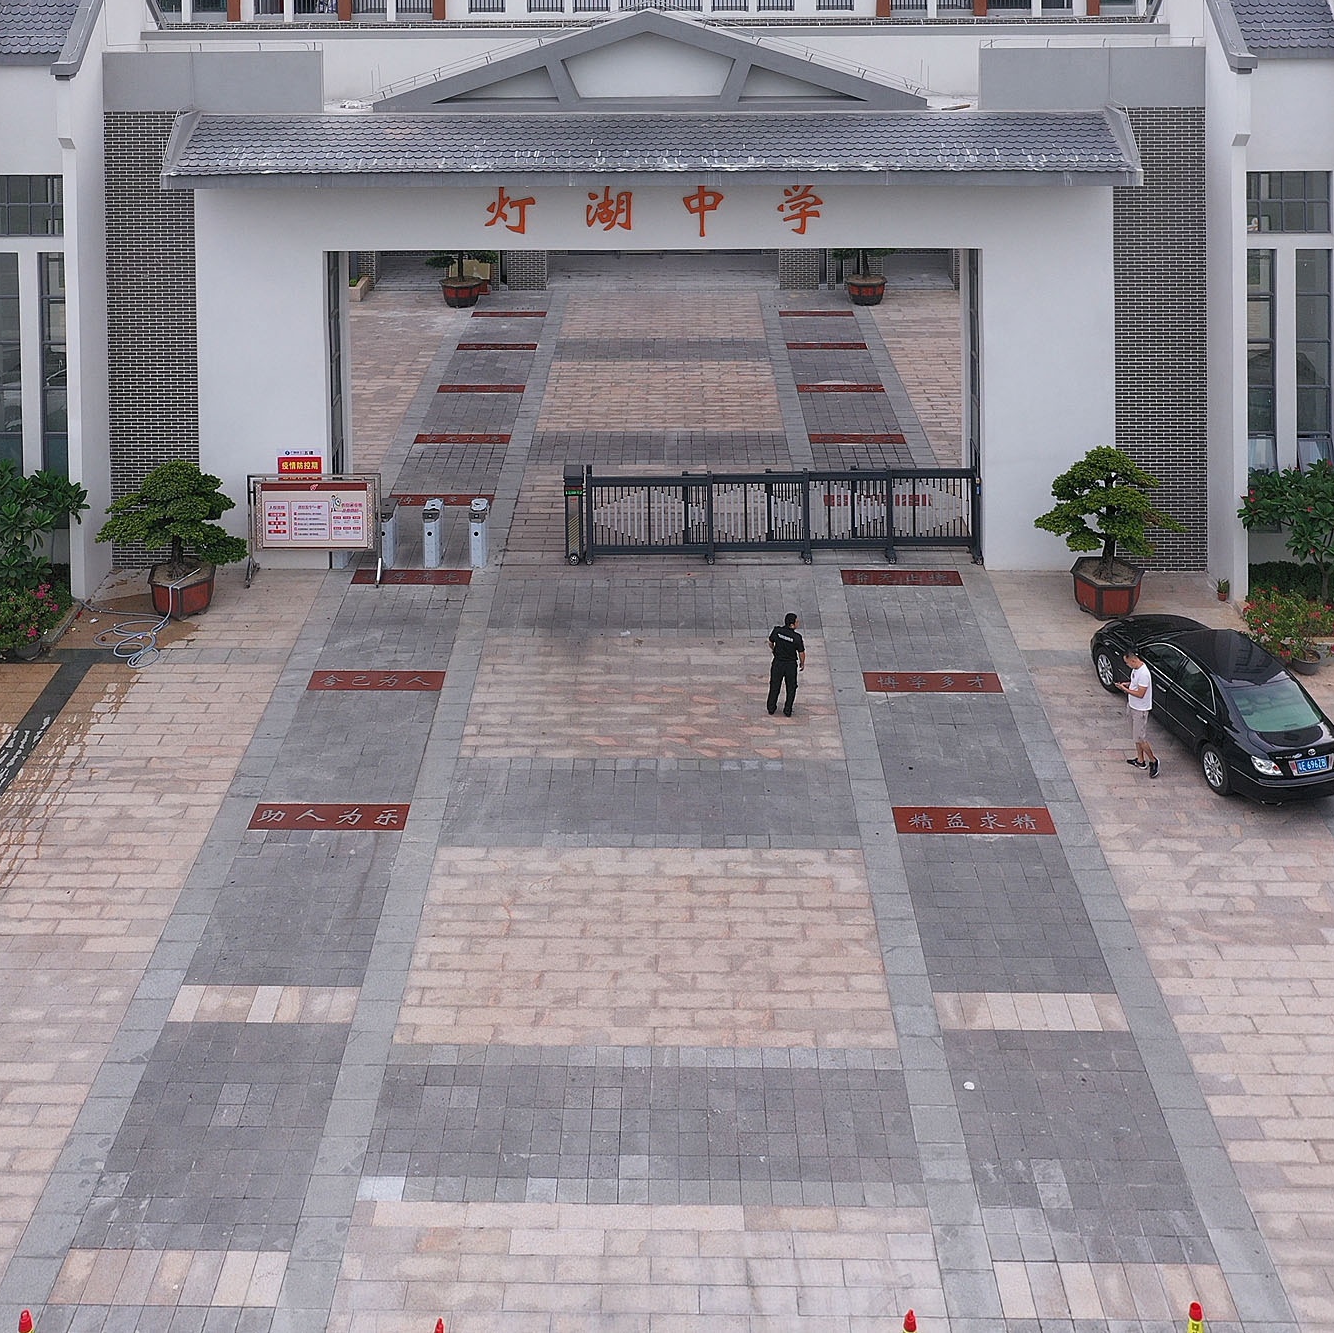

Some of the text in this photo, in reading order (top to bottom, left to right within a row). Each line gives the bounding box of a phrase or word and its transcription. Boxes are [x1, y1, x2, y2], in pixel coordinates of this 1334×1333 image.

[484, 186, 824, 237] 灯湖中学
[319, 674, 432, 687] 舍己为人
[877, 675, 984, 689] 博学多才
[257, 808, 398, 826] 助人为乐
[908, 812, 1037, 830] 精益求精
